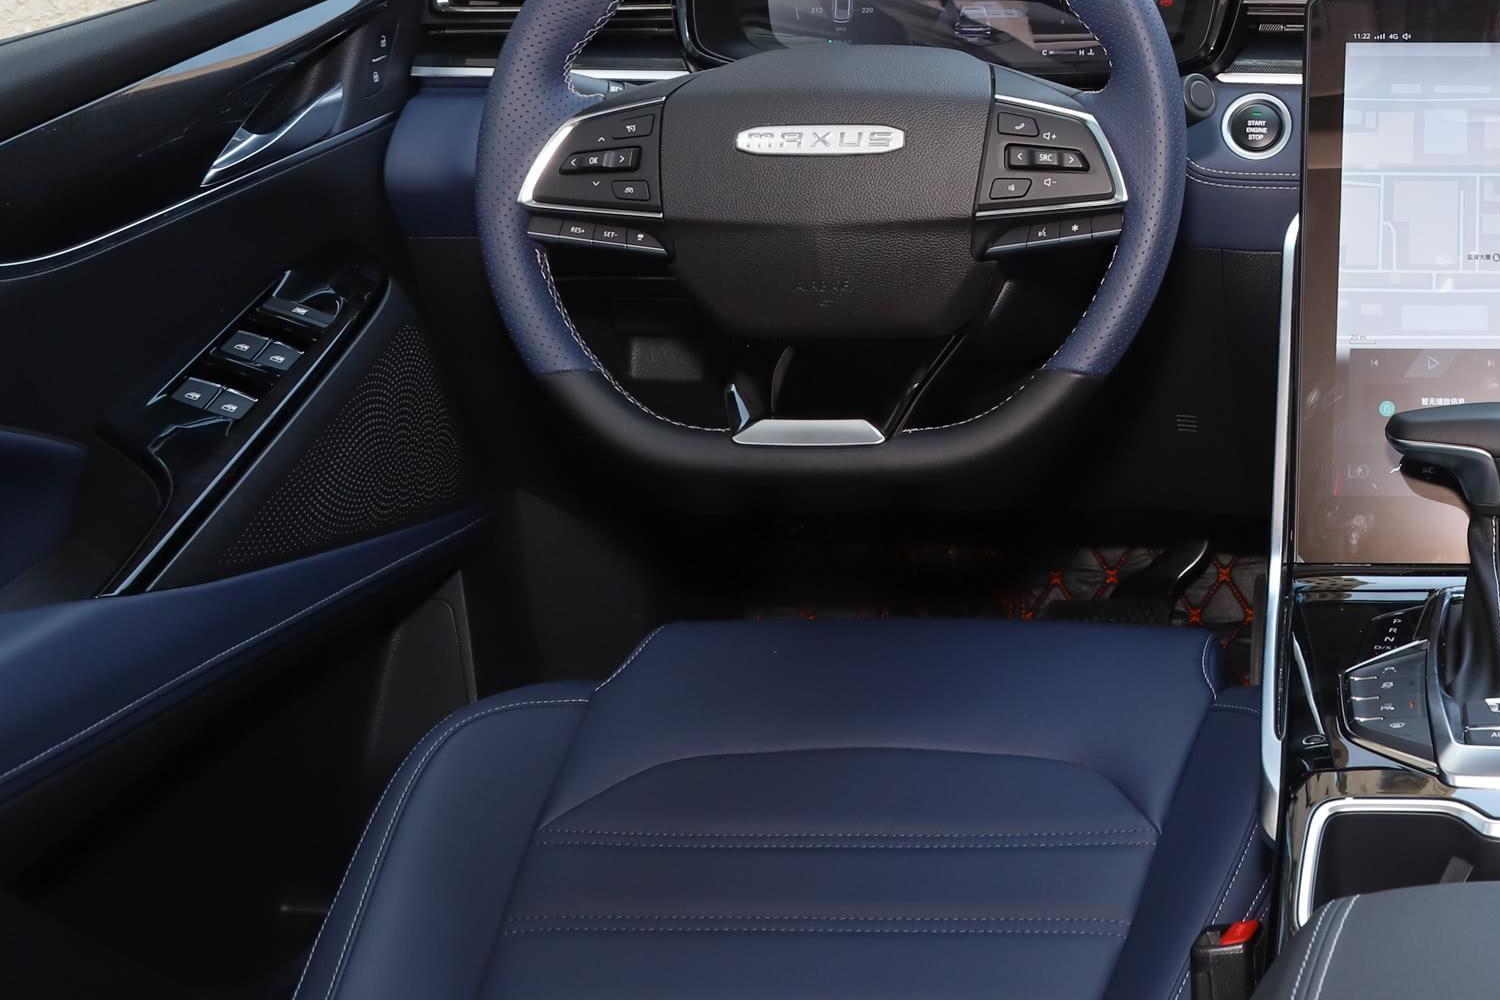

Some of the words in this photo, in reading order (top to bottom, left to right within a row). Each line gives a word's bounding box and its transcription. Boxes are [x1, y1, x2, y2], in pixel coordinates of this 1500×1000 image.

[747, 131, 893, 148] MAXUS
[588, 156, 599, 165] OK
[1039, 153, 1053, 162] SRC
[1421, 397, 1465, 406] 暂无播放信息
[1422, 466, 1435, 474] AC
